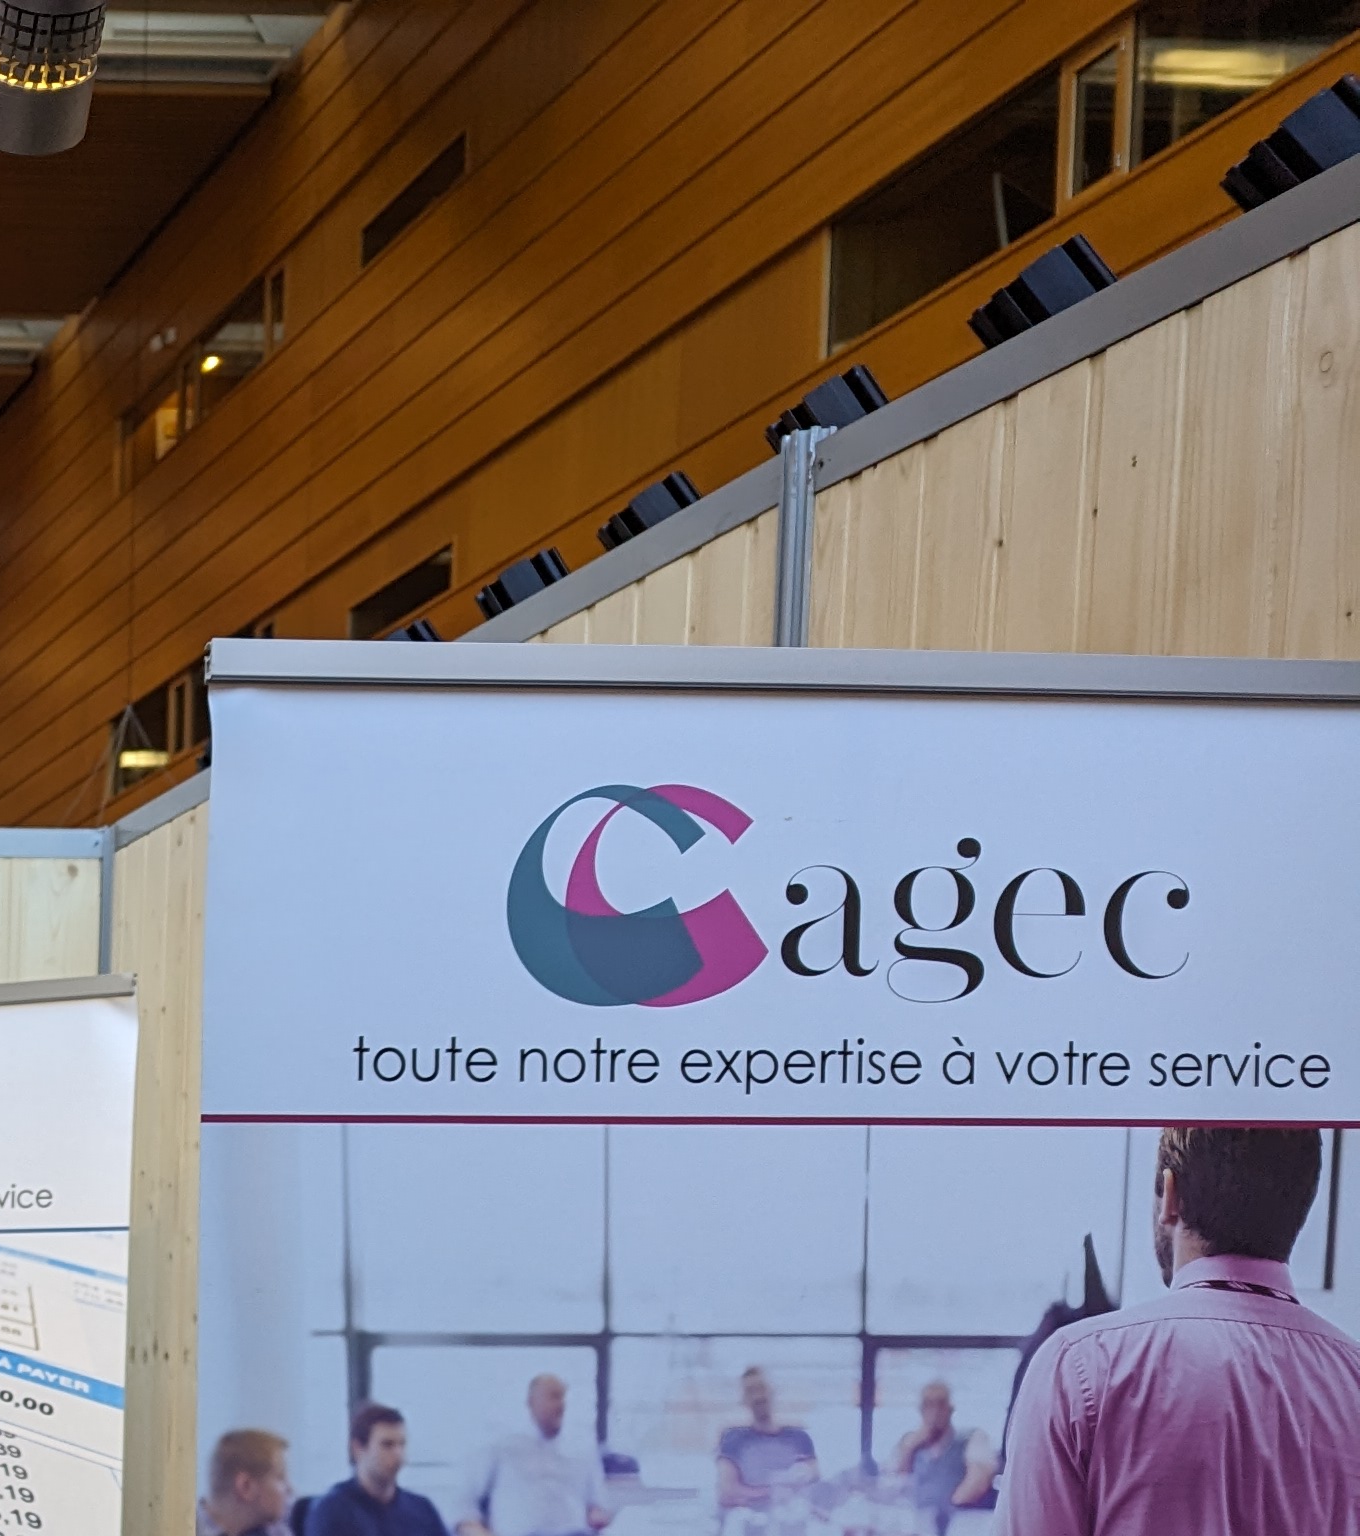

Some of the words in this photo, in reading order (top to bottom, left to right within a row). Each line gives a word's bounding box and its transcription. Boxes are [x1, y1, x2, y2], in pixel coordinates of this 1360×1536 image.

[353, 1035, 498, 1084] toute
[518, 1037, 660, 1084] notre
[679, 1036, 922, 1095] expertise
[941, 1037, 976, 1085] à
[995, 1042, 1129, 1088] votre
[1149, 1043, 1331, 1090] service
[17, 1363, 90, 1393] PAYER
